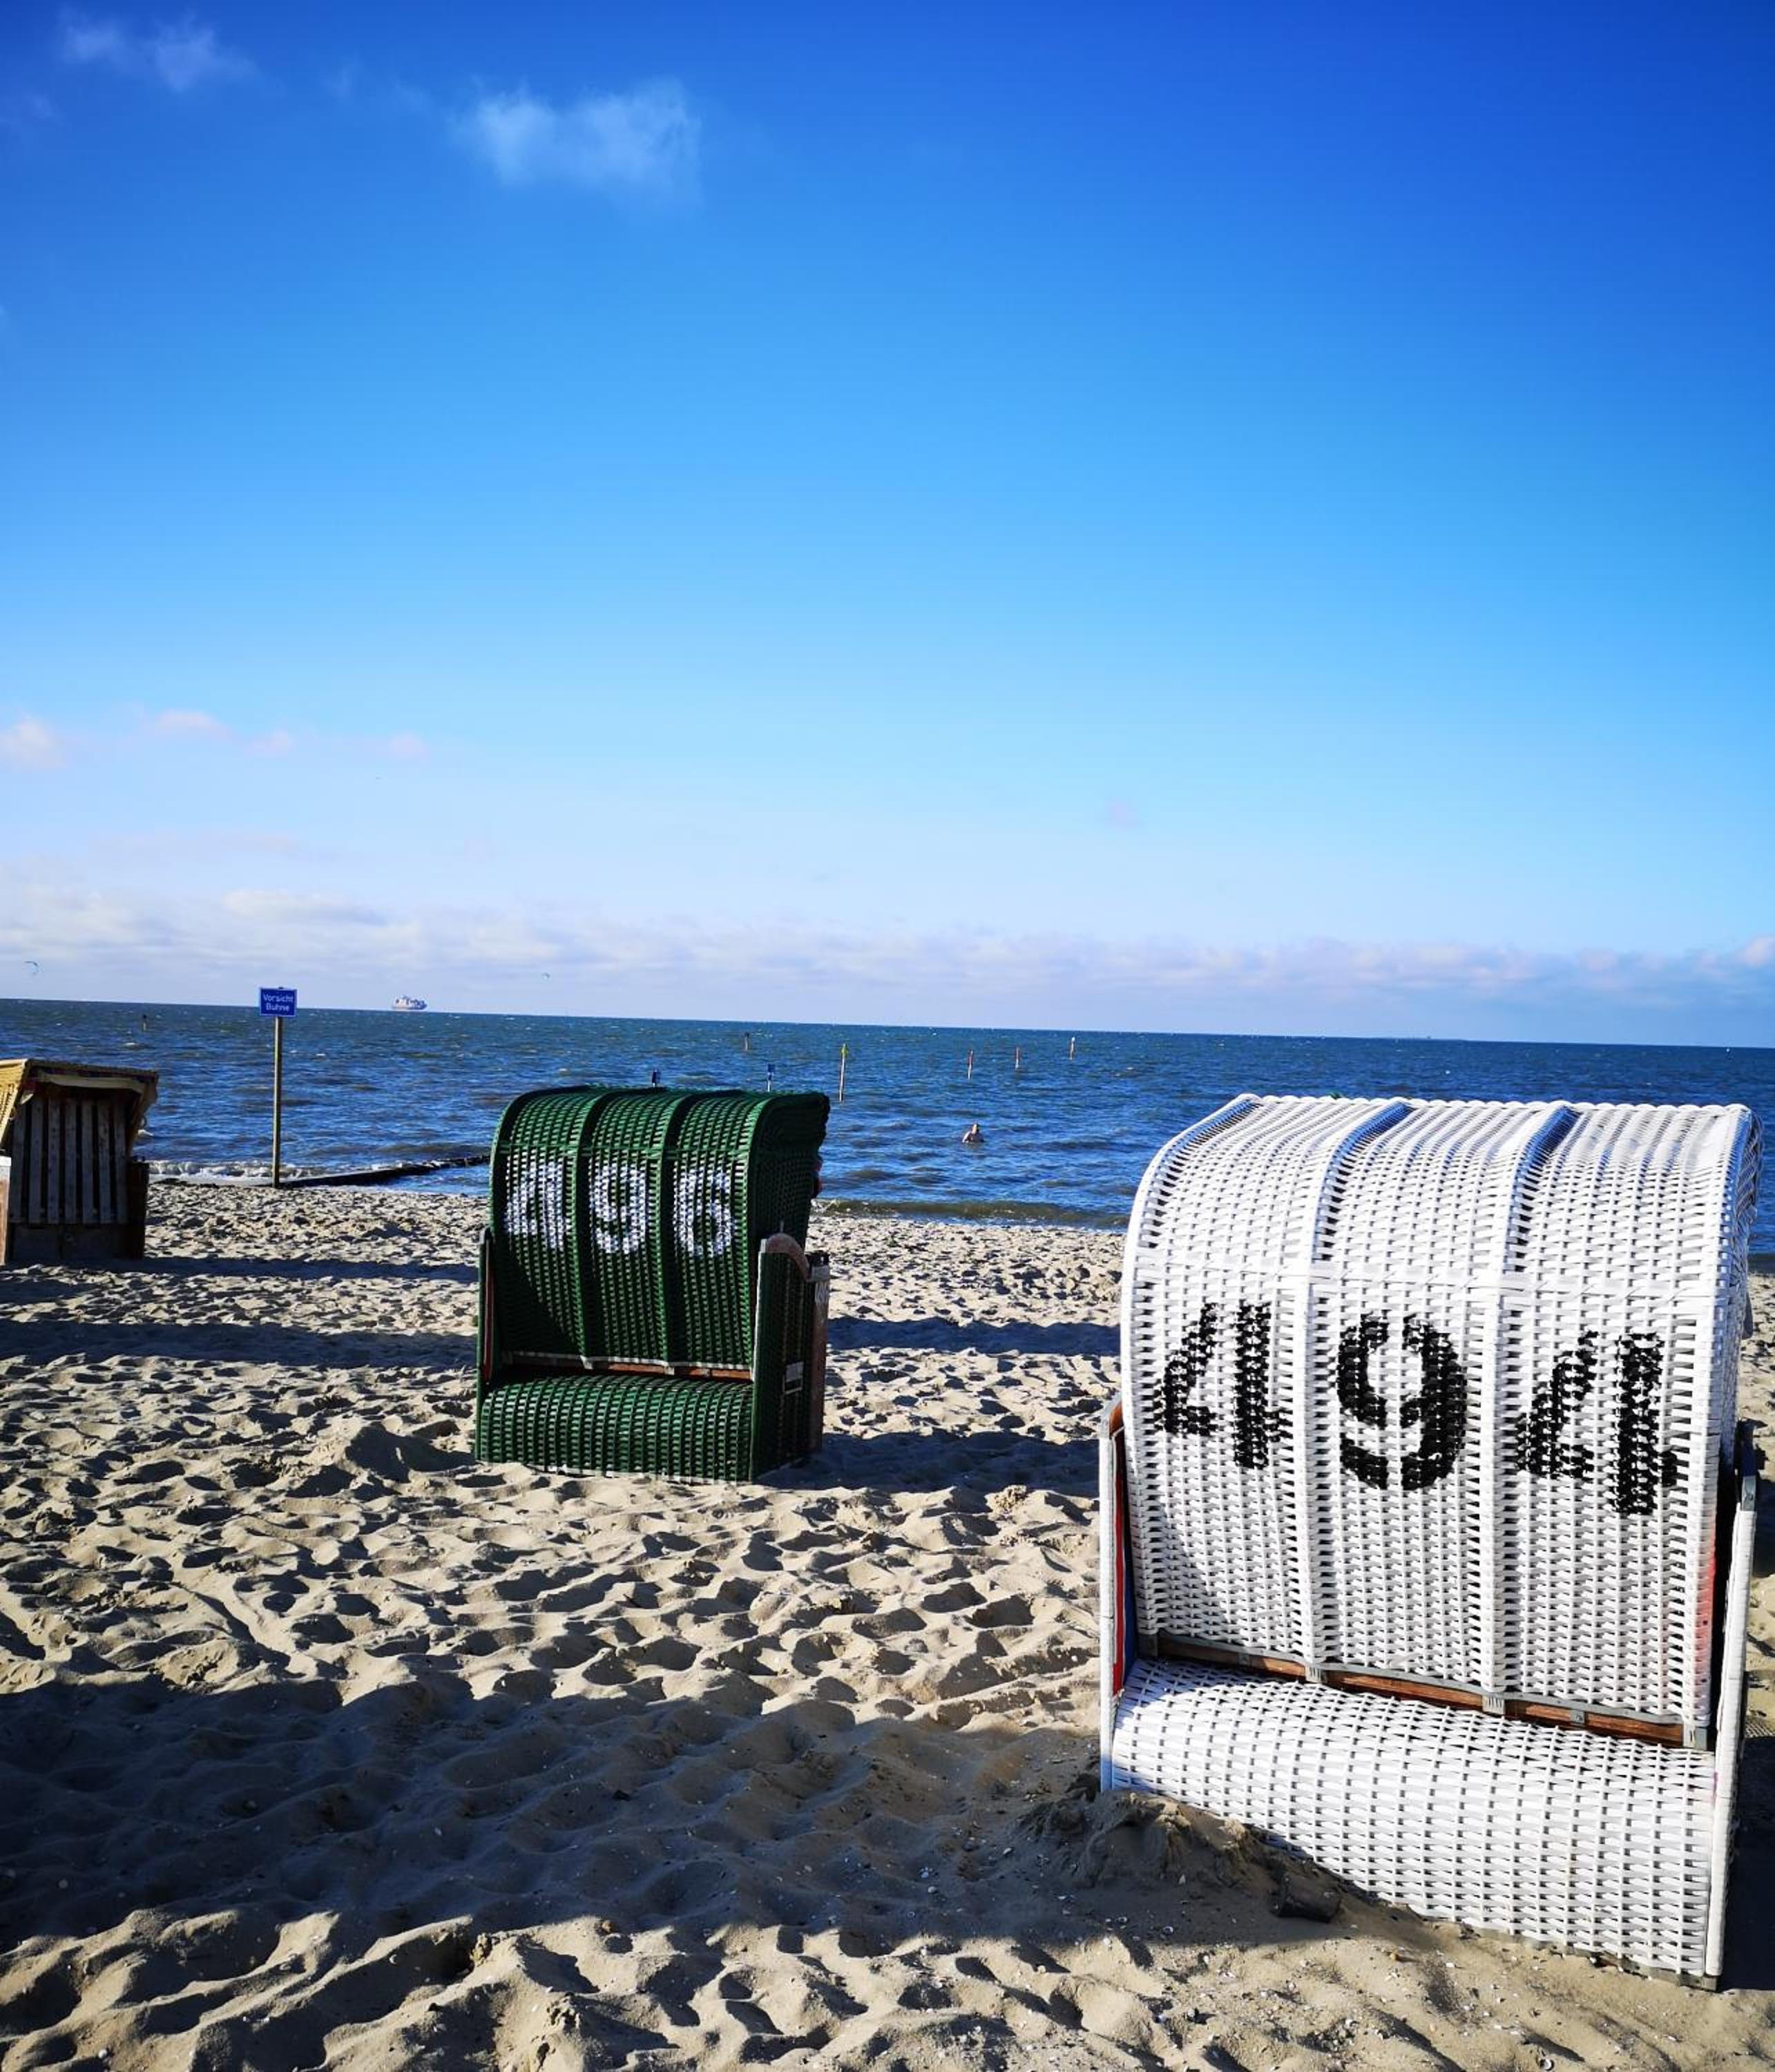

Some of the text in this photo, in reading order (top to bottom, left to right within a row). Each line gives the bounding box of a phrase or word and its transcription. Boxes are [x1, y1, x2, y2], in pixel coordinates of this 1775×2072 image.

[263, 994, 294, 1003] Vorsicht
[505, 1161, 736, 1258] 496
[1153, 1301, 1679, 1516] 494
